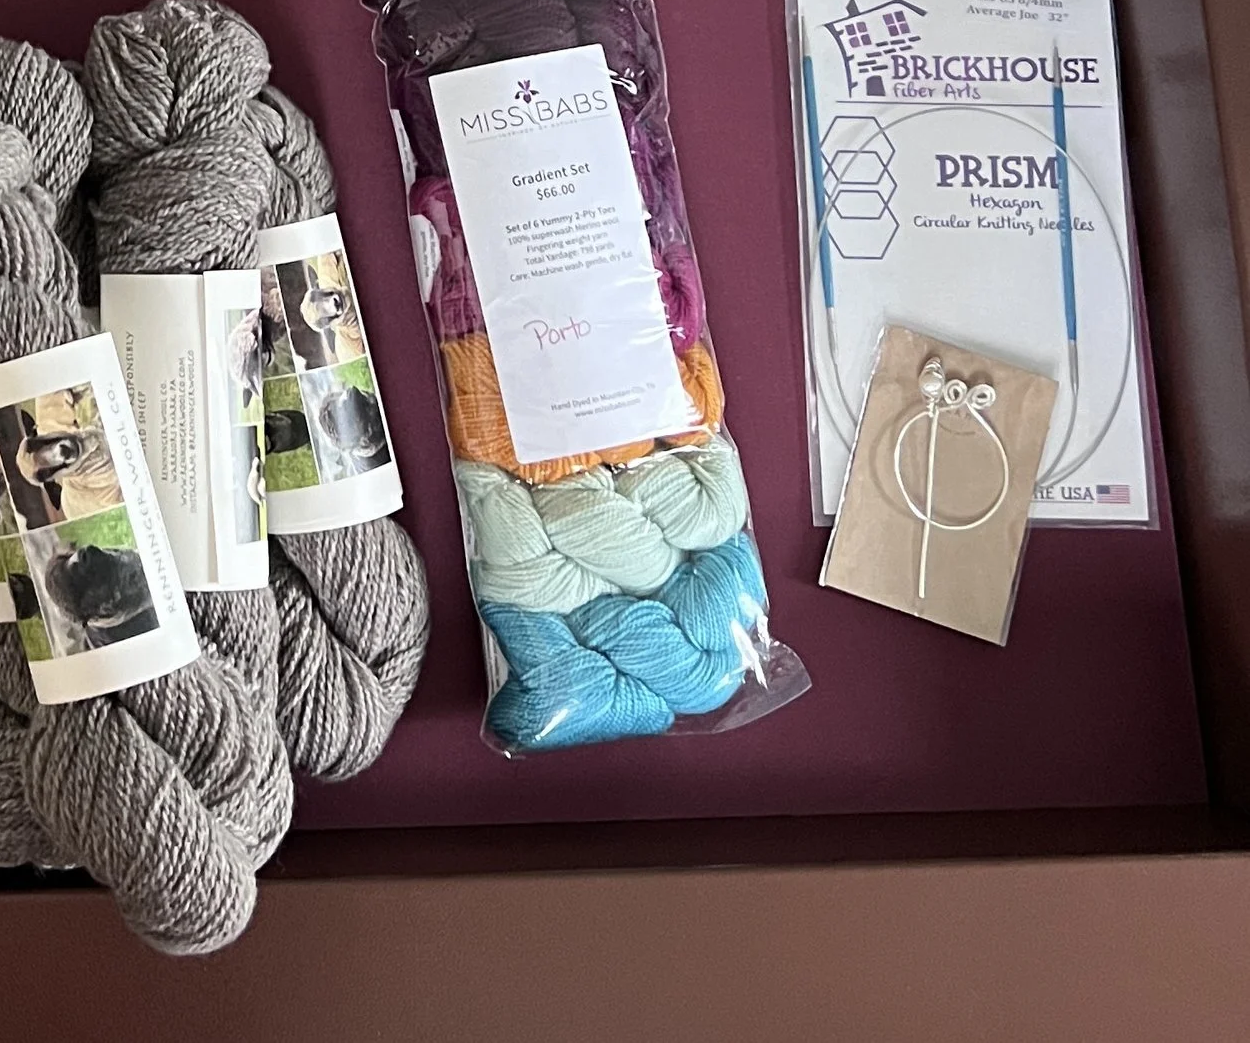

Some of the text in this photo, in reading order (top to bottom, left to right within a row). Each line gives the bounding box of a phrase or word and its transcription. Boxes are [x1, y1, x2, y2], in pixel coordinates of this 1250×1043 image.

[966, 6, 1016, 19] Average
[891, 55, 1099, 83] BRICKHOUSE
[894, 83, 981, 99] Fiber Arts
[461, 106, 524, 136] MISS
[536, 90, 608, 121] BABS
[512, 162, 590, 187] Gradient Set
[936, 154, 1060, 189] PRISM
[537, 183, 575, 201] $66.00
[970, 194, 1043, 216] Hexagon
[504, 223, 521, 234] Set
[523, 222, 531, 230] of
[533, 220, 540, 228] 6
[539, 214, 573, 227] Yummy
[914, 217, 971, 229] Circular
[978, 217, 1034, 235] Knitting
[526, 240, 564, 254] Fingering
[523, 317, 591, 350] Porto
[115, 421, 138, 485] WOOL
[1061, 487, 1094, 500] USA
[138, 487, 176, 613] RENNINGER
